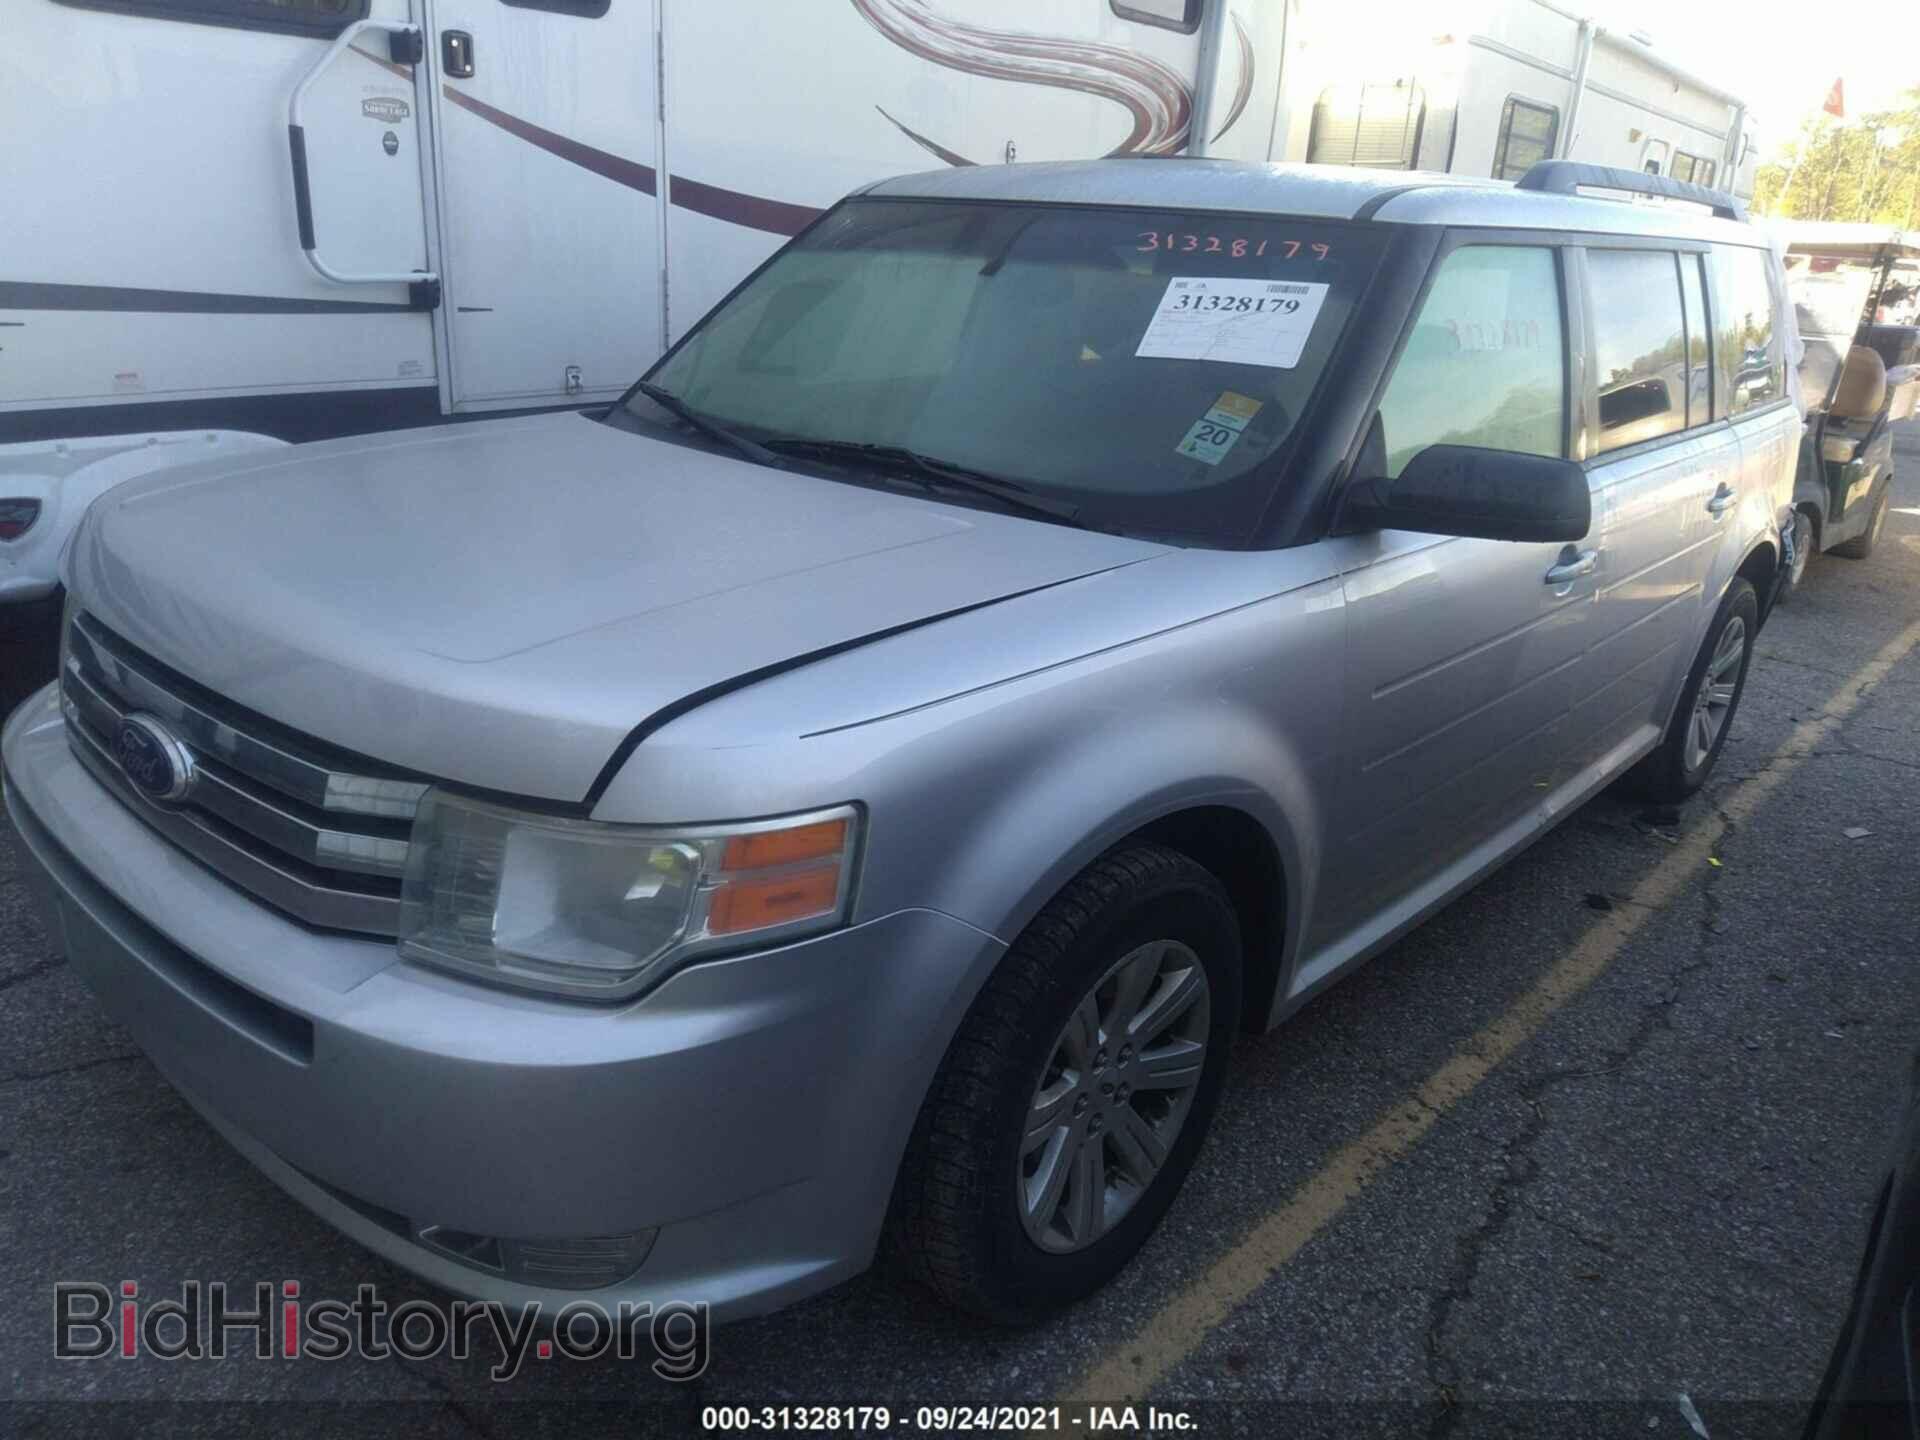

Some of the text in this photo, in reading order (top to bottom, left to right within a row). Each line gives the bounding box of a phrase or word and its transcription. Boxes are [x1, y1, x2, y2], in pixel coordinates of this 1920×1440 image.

[1137, 232, 1330, 260] 31328179
[1173, 294, 1301, 315] 31328179
[1194, 424, 1230, 446] 20
[119, 729, 162, 784] Ford
